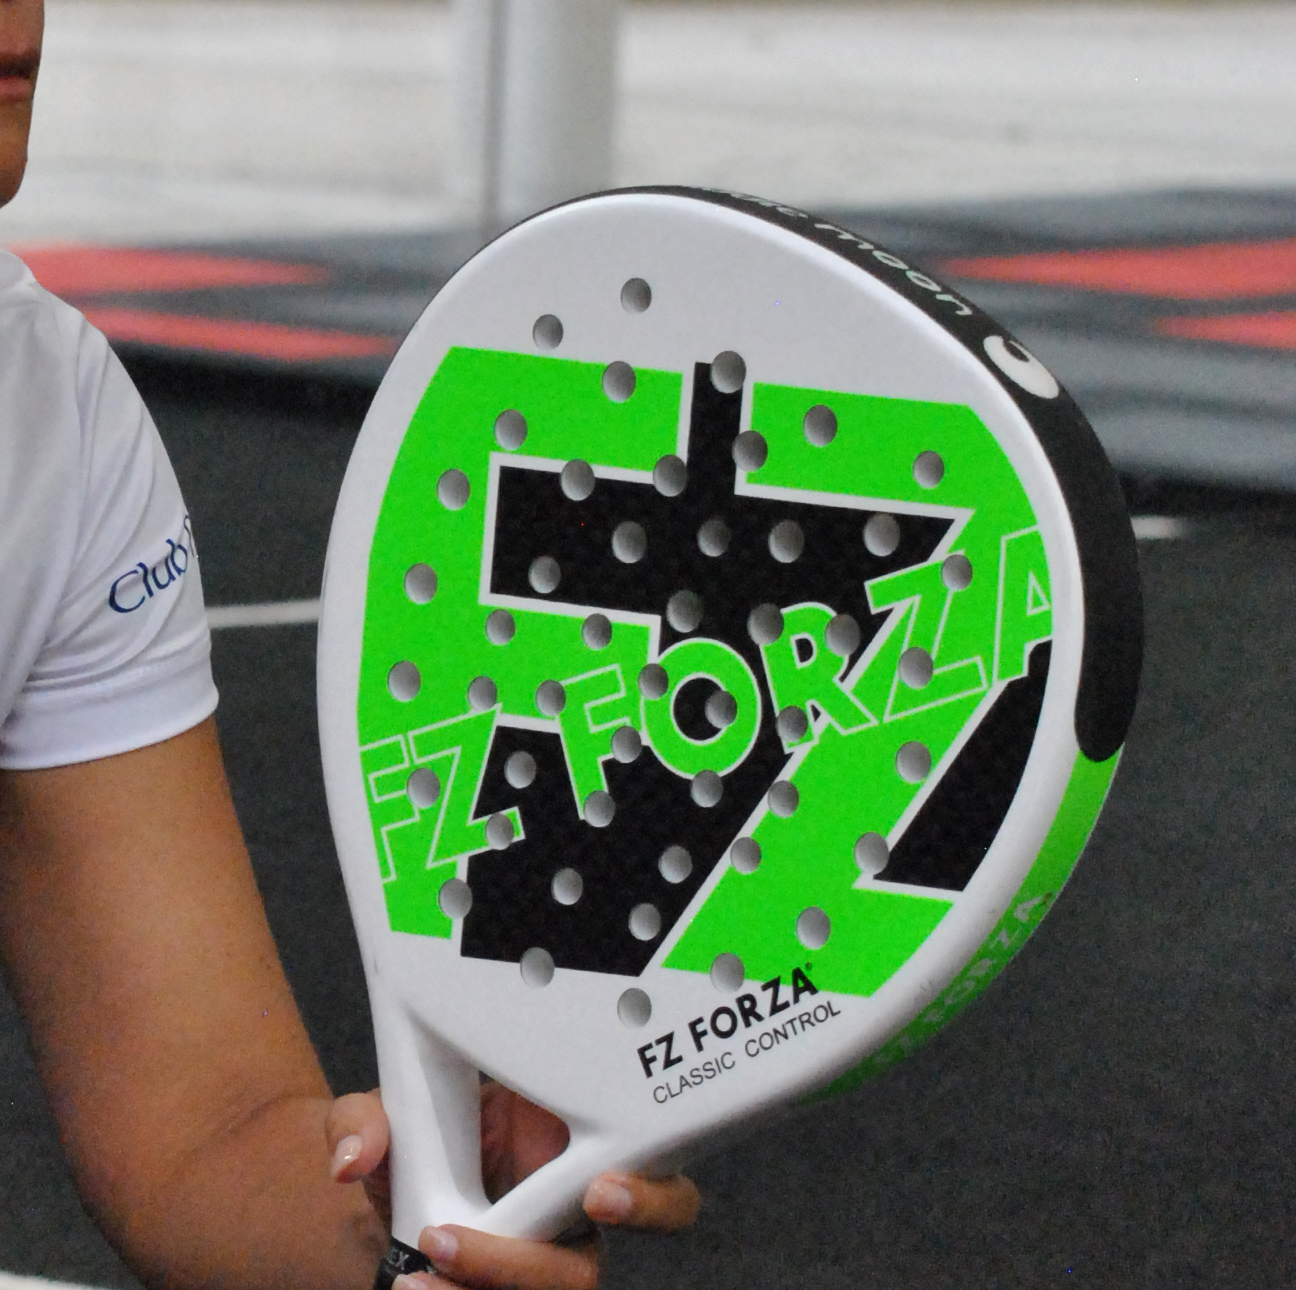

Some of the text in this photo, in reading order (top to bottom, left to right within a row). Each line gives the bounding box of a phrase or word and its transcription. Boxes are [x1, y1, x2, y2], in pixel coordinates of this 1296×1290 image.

[814, 222, 973, 316] moon
[109, 538, 188, 614] Club
[359, 526, 1053, 883] FZ FORZA
[637, 1031, 684, 1079] FZ
[688, 966, 820, 1053] FORZA
[653, 1051, 736, 1104] CLASSIC
[744, 1000, 842, 1058] CONTROL
